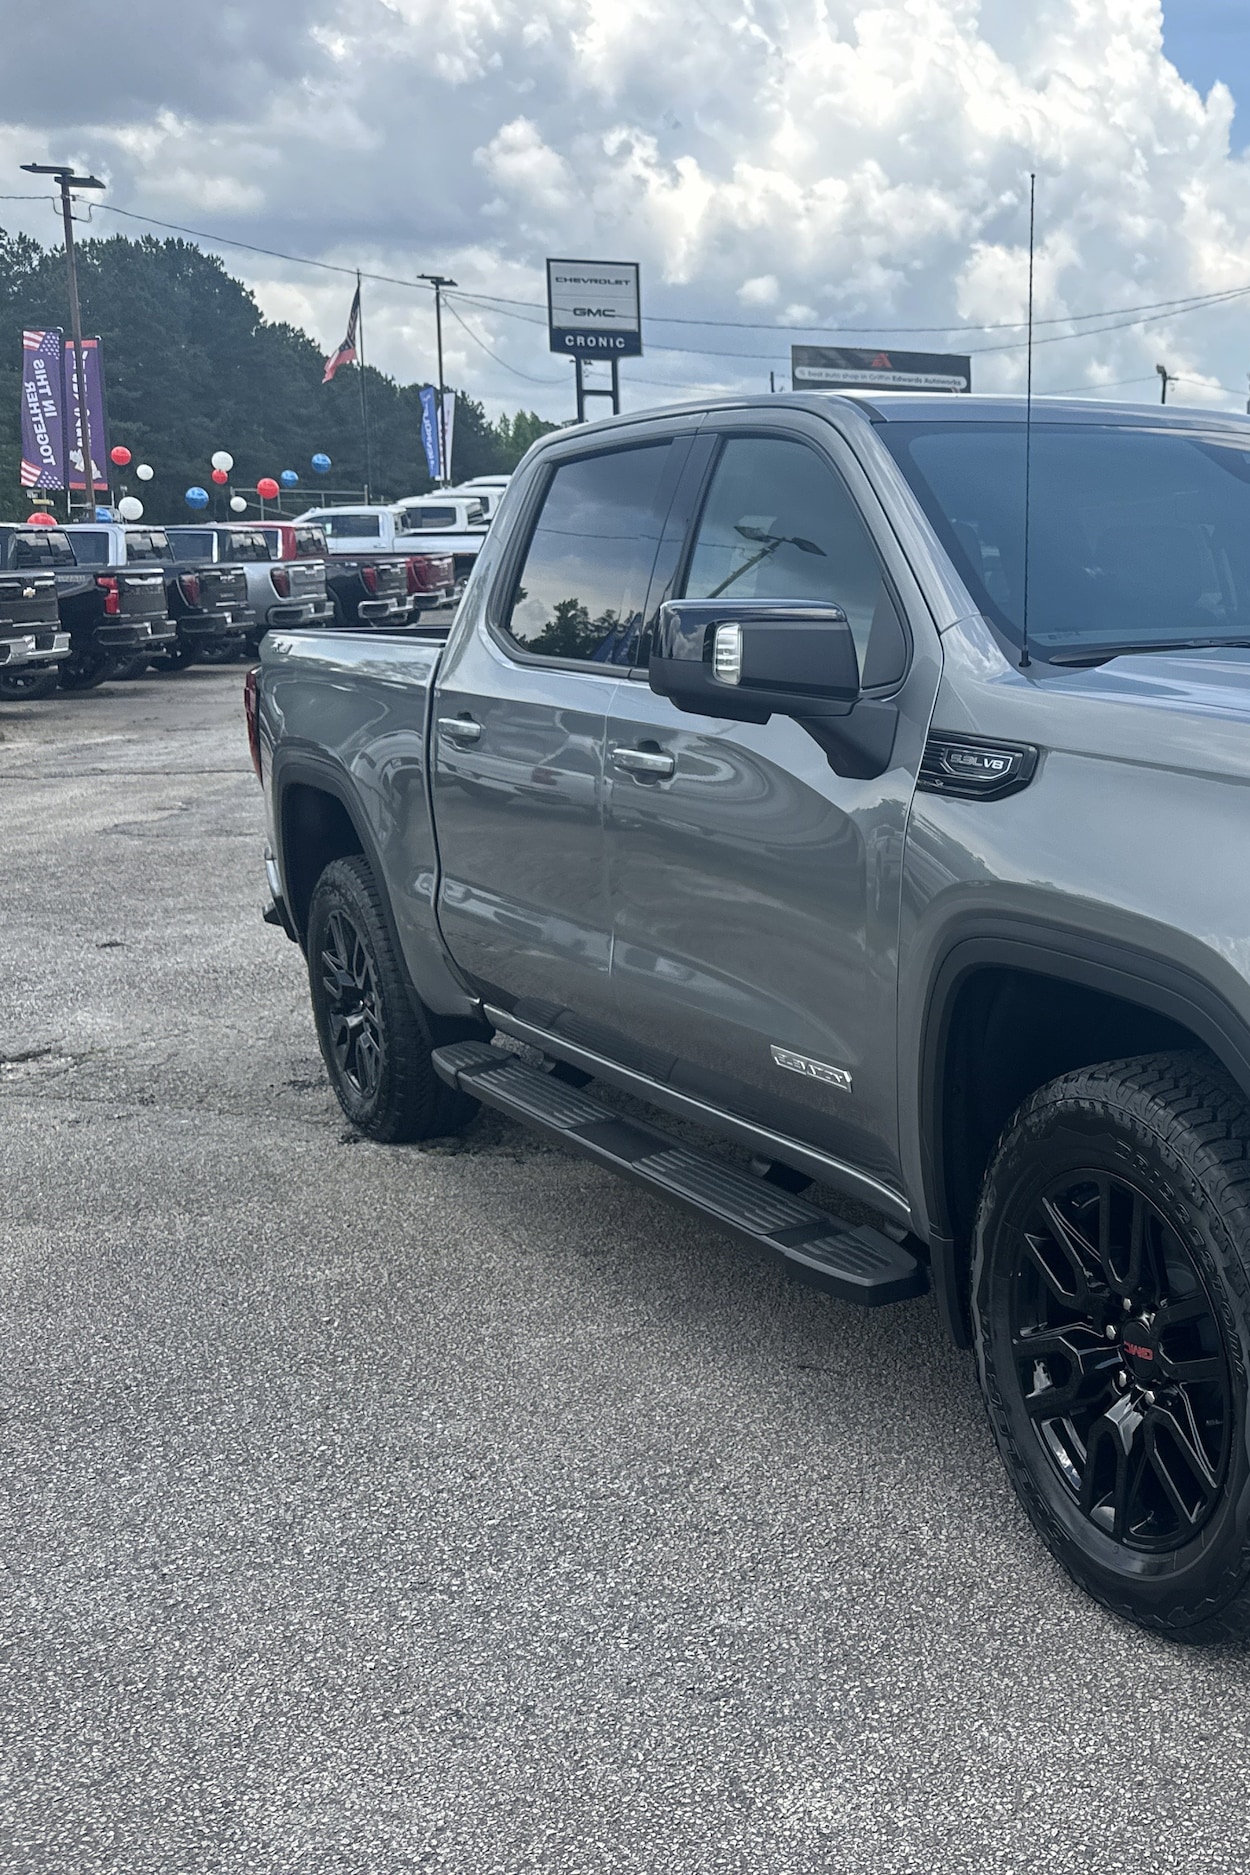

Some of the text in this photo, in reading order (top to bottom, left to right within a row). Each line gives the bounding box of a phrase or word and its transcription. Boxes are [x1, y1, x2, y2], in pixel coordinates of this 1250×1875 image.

[555, 277, 631, 285] CHEVROLET
[573, 307, 616, 317] GMC
[565, 335, 625, 348] CRONIC
[842, 373, 860, 381] shop
[892, 375, 922, 384] Edwards
[924, 377, 961, 386] Autoworks
[1113, 1138, 1247, 1376] BRIDGESTONE
[1123, 1340, 1154, 1361] GMC
